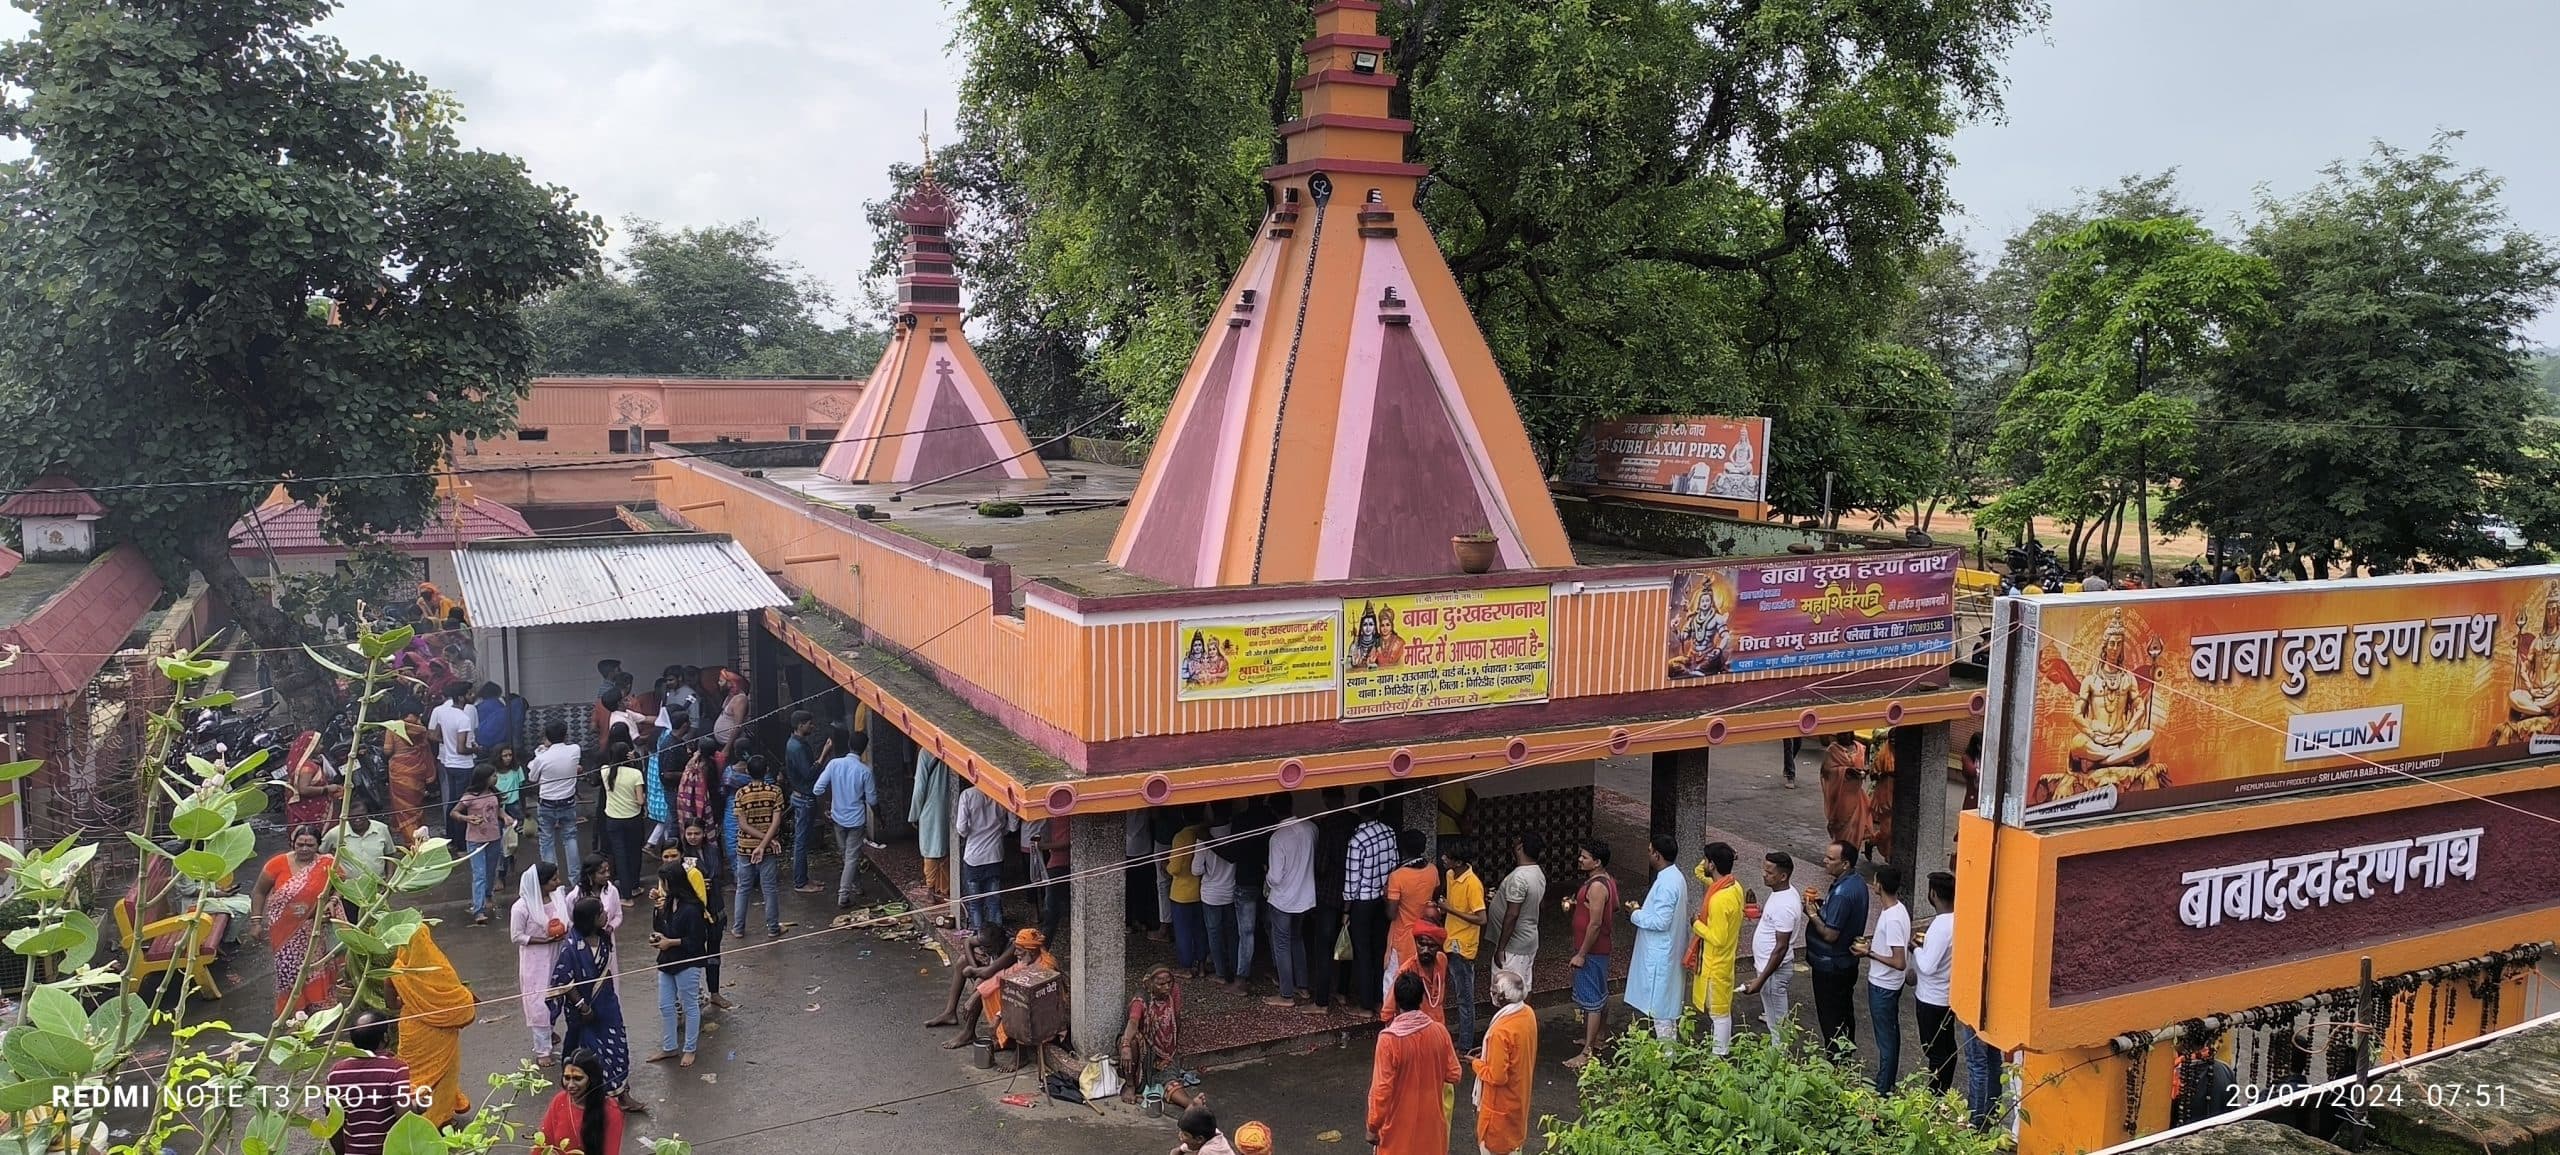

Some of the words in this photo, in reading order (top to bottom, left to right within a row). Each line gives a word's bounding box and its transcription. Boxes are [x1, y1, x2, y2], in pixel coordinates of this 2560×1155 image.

[1611, 440, 1642, 454] SUBH
[1645, 441, 1686, 456] LAXMI
[1688, 442, 1727, 460] PIPES
[1760, 566, 1807, 584] बाबा
[1812, 563, 1851, 588] दुख
[1857, 560, 1905, 579] हरण
[1909, 556, 1948, 573] नाथ
[1402, 608, 1438, 627] बाबा
[1443, 600, 1547, 630] दुःखहरणनाथ
[1800, 581, 1887, 624] महाशिवरात्रि
[1244, 627, 1259, 637] बाबा
[1310, 620, 1328, 632] मंदिर
[1738, 636, 1772, 652] शिव
[1808, 627, 1840, 645] आर्ट
[1404, 637, 1434, 666] मंदिर
[1436, 634, 1448, 663] में
[1449, 640, 1488, 662] आपका
[1490, 636, 1528, 659] स्वागत
[2190, 629, 2279, 681] बाबा
[2280, 626, 2348, 695] दुख
[2352, 620, 2426, 676] हरण
[2429, 613, 2498, 659] नाथ
[1346, 677, 1368, 688] स्थान
[1376, 674, 1394, 684] ग्राम
[1442, 666, 1456, 677] वार्ड
[1482, 663, 1508, 674] पंचायत
[1358, 688, 1376, 698] थाना
[1384, 684, 1414, 696] गिरिडीह
[1440, 678, 1459, 691] जिला
[1466, 676, 1494, 688] गिरिडीह
[1346, 698, 1410, 717] ग्रामवासियों
[1428, 694, 1466, 708] सौजन्य
[2240, 782, 2264, 792] PREMIUM
[2264, 780, 2286, 790] QUALITY
[2286, 777, 2310, 786] PRODUCT
[2311, 776, 2318, 784] OF
[2318, 772, 2330, 783] SRI
[2331, 769, 2358, 782] LANGTA
[2359, 766, 2378, 778] BABA
[2379, 762, 2404, 776] STEELS
[2405, 760, 2416, 772] (P)
[2416, 758, 2440, 770] LIMITED
[2180, 860, 2270, 928] बाबा
[2264, 850, 2340, 922] दुख
[2334, 839, 2414, 904] हरण
[2409, 828, 2484, 888] नाथ
